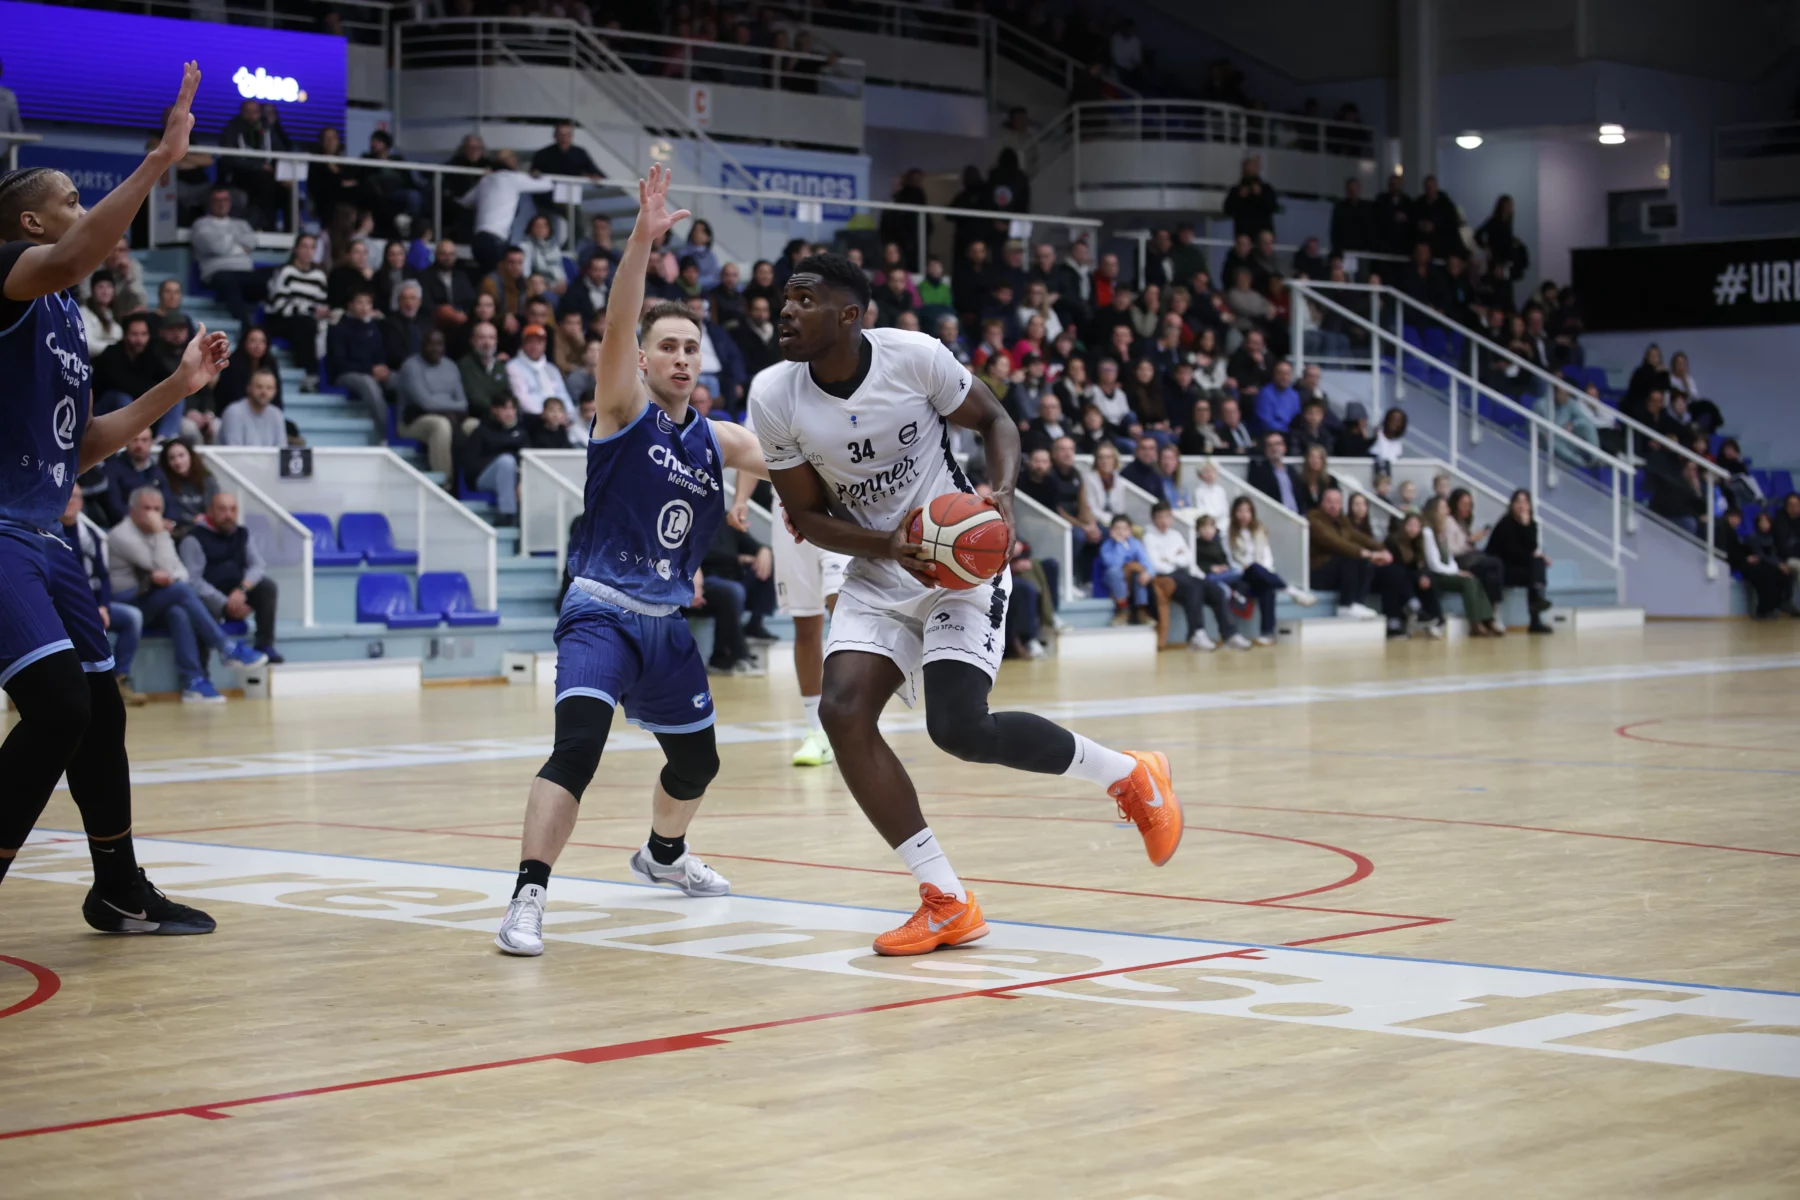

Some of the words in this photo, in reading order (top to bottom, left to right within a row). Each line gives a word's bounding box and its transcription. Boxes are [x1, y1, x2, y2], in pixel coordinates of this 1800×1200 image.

[757, 171, 853, 199] rennes
[847, 438, 876, 464] 34
[667, 471, 708, 497] Métropole
[843, 468, 920, 509] AKETBALL
